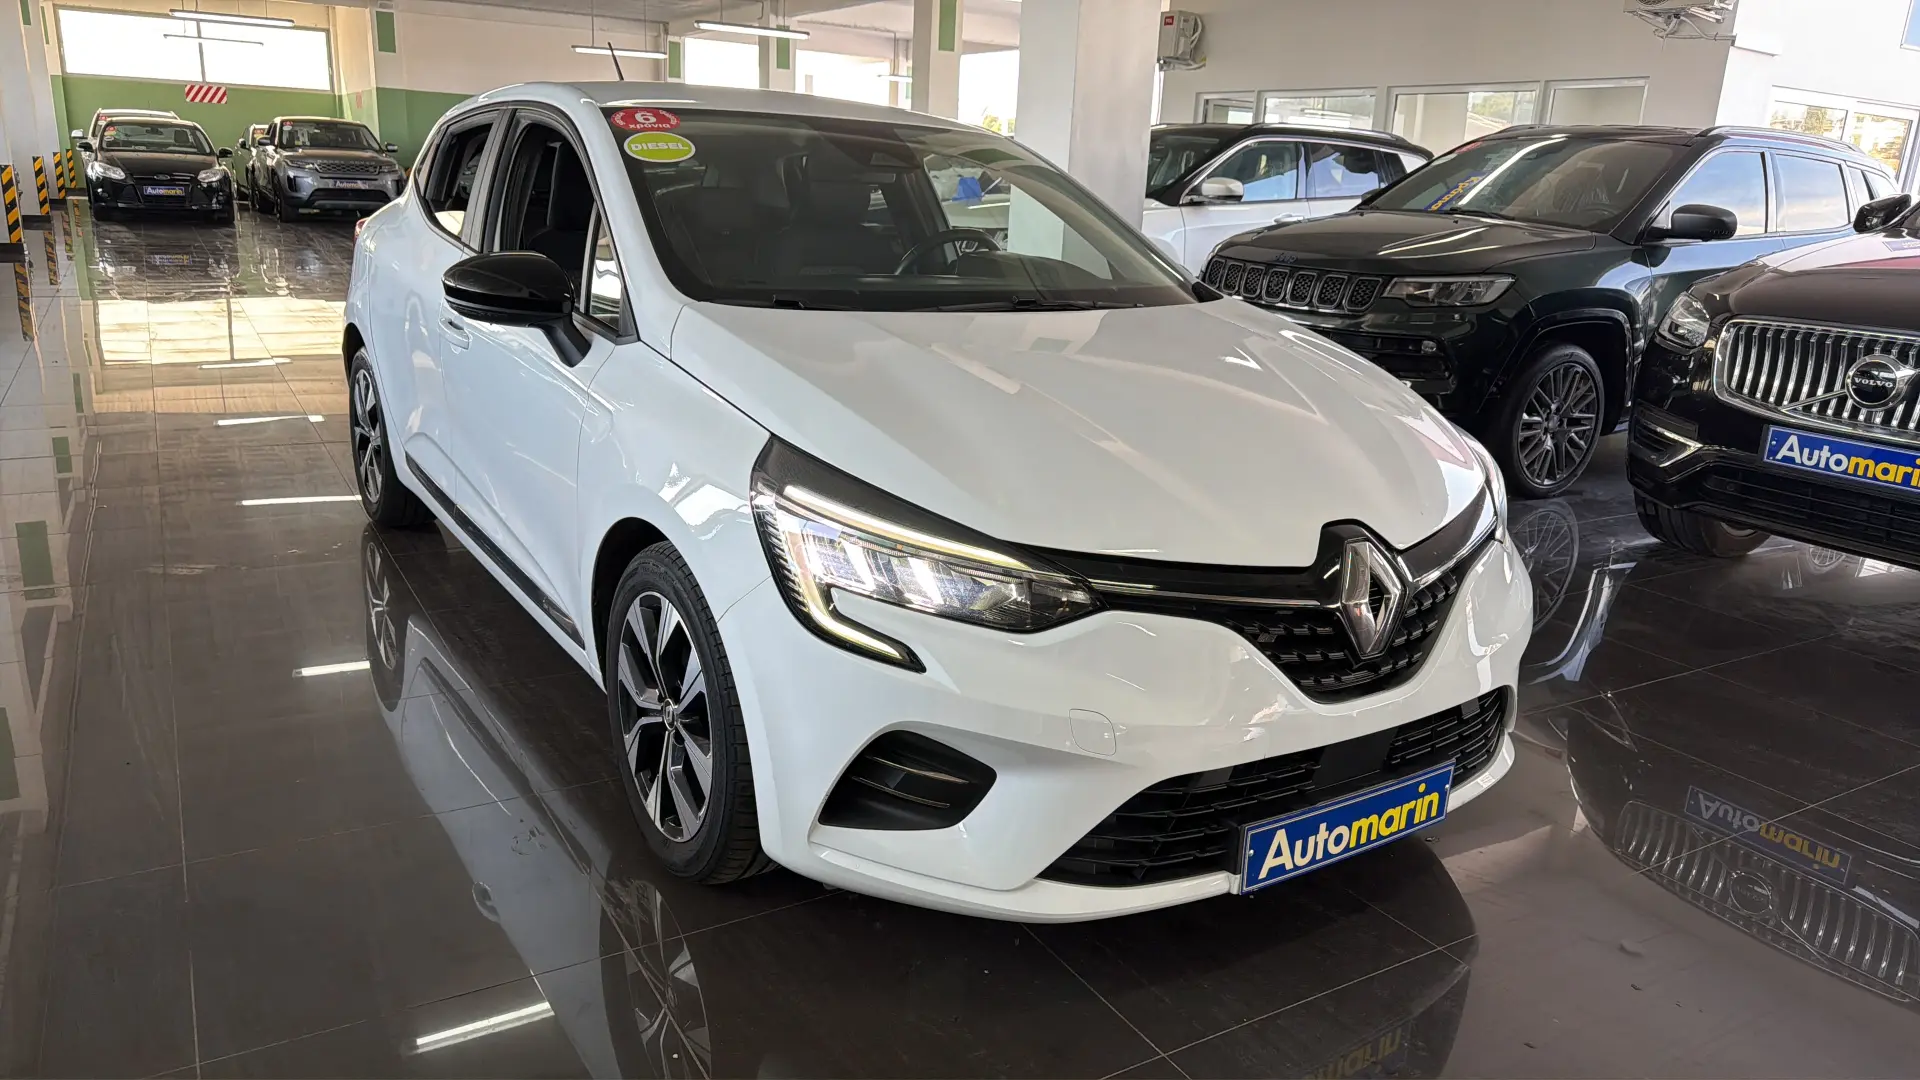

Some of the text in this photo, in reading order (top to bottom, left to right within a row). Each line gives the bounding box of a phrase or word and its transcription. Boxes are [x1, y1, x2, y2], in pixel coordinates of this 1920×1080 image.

[634, 112, 657, 124] 6
[631, 142, 689, 151] DIESEL
[1853, 377, 1895, 388] VOLVO
[1775, 434, 1920, 488] Automari
[1257, 782, 1440, 880] Automarin
